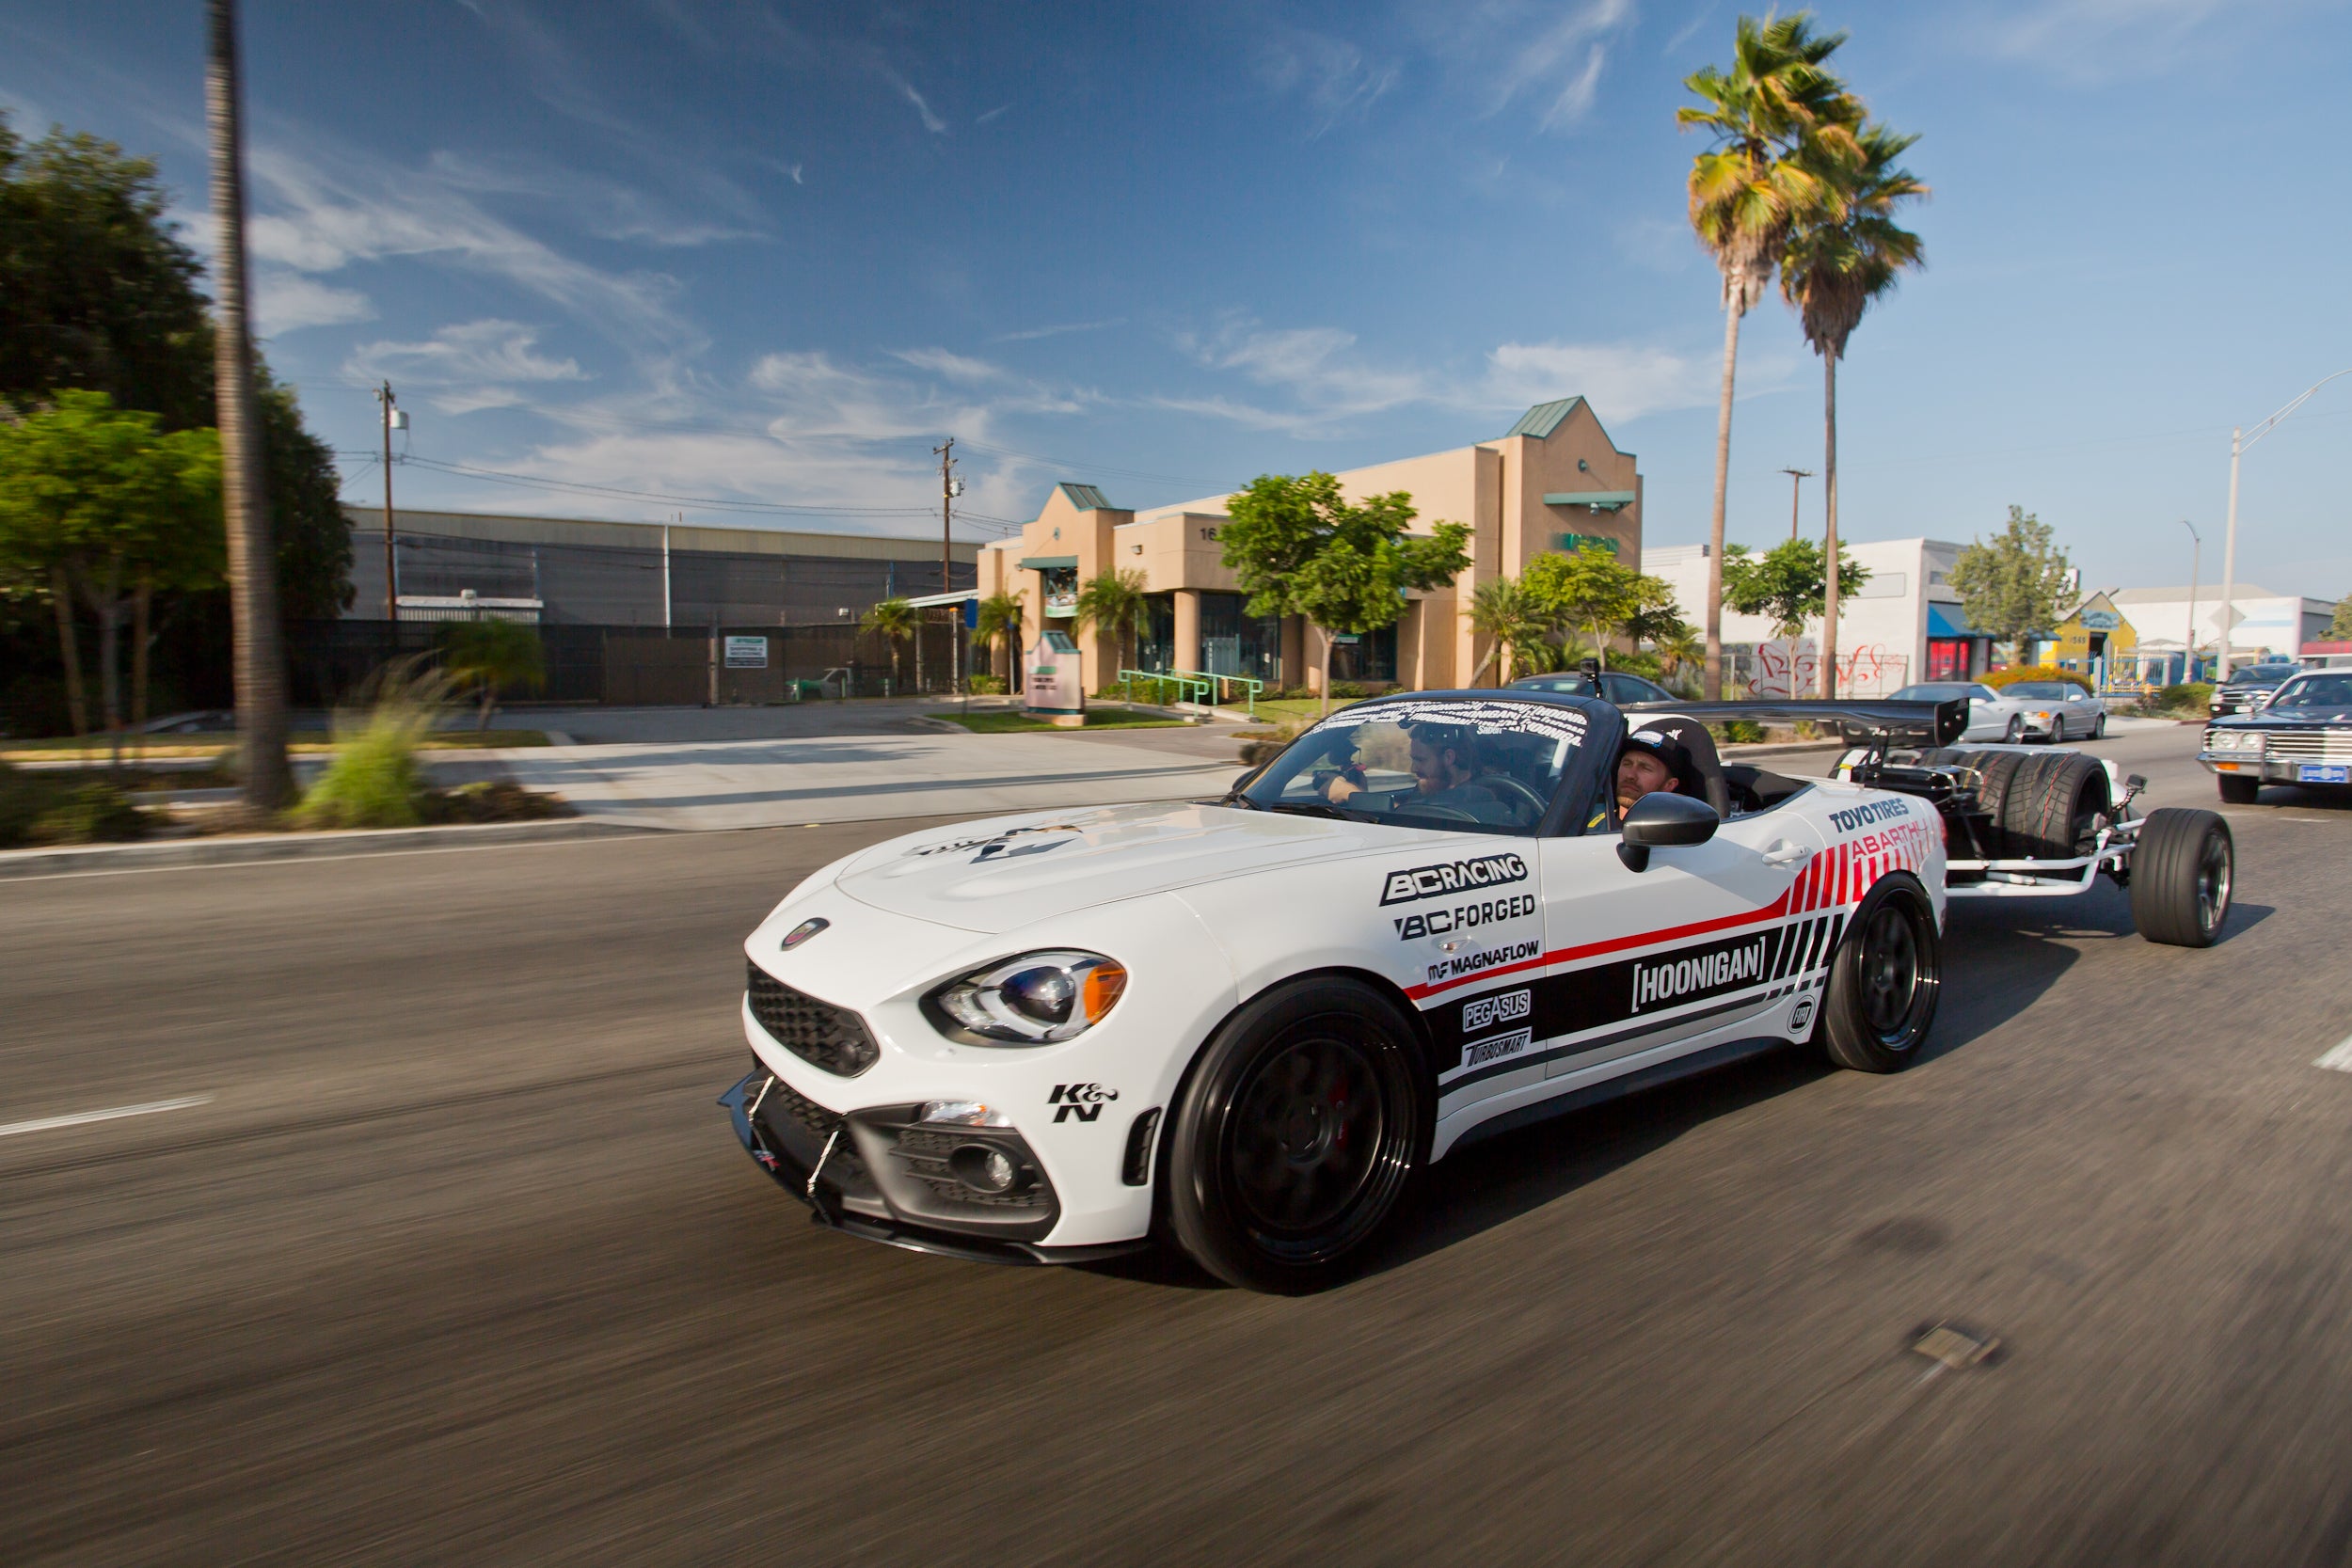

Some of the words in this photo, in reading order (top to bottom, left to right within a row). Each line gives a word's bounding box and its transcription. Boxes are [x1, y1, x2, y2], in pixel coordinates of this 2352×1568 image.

[1851, 820, 1920, 860] ABARTH
[1454, 894, 1535, 930] FORGED
[1452, 941, 1539, 975] MAGNAFLOW
[1466, 993, 1528, 1027] PEGASUS
[1792, 1006, 1811, 1024] FIAT
[1465, 1030, 1530, 1068] TURBOSMART
